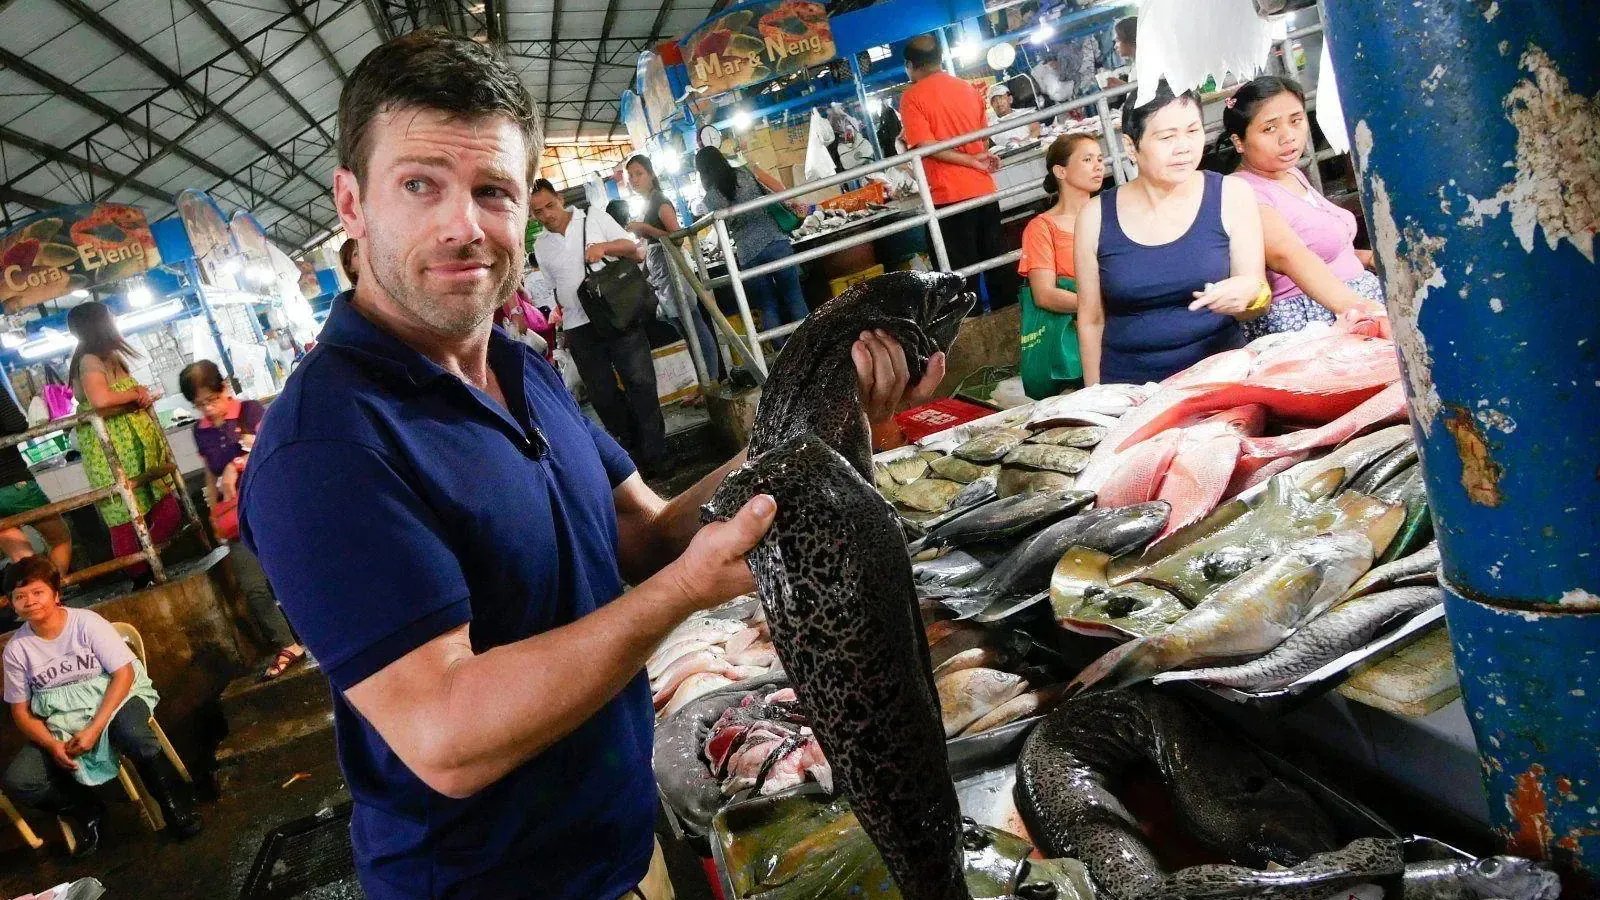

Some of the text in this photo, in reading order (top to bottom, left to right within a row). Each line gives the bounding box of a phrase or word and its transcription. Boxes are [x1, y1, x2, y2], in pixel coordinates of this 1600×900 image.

[695, 35, 821, 82] Mar & Neng
[4, 264, 63, 292] Cora
[77, 242, 145, 271] Eleng
